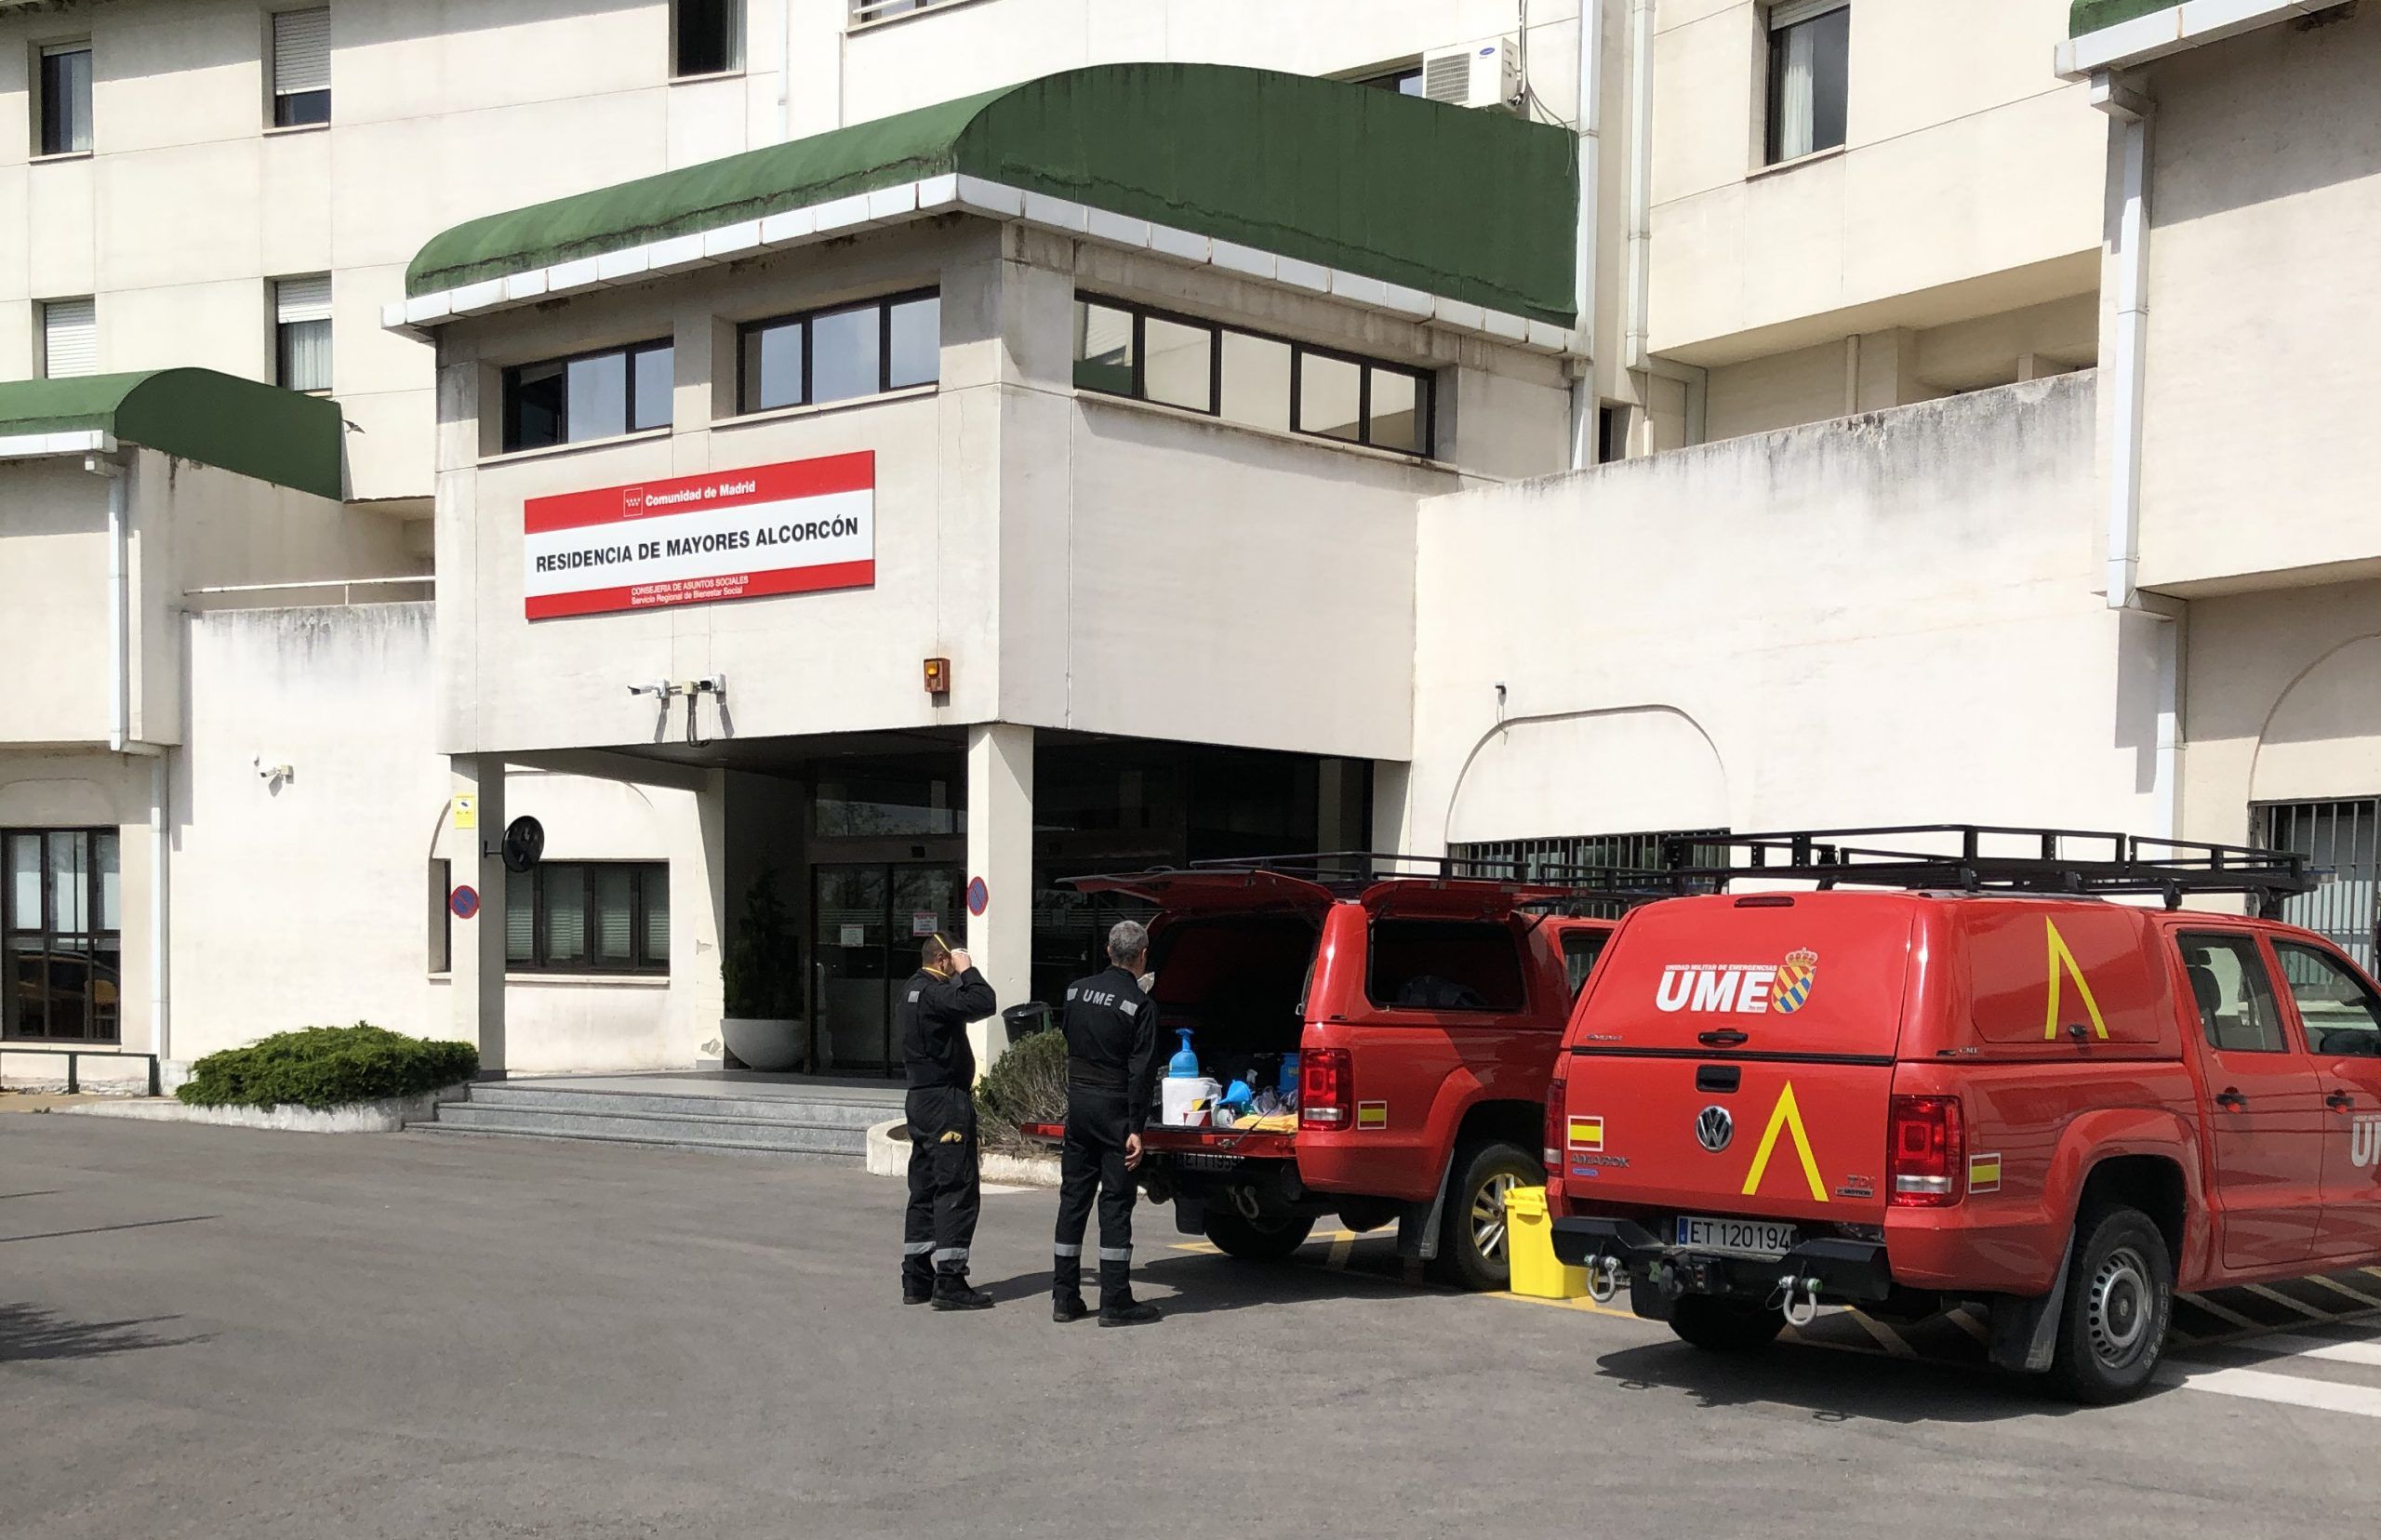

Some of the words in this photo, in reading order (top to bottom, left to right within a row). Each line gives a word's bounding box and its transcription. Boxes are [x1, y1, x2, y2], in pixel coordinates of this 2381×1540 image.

[645, 488, 701, 507] Comunidad
[704, 486, 717, 498] de
[719, 480, 756, 498] Madrid
[536, 545, 632, 573] RESIDENCIA
[638, 541, 661, 561] DE
[667, 530, 751, 558] MAYORES
[755, 513, 858, 547] ALCORCÓN
[672, 582, 682, 591] DE
[683, 578, 714, 591] ASUNTOS
[715, 575, 749, 587] SOCIALES
[631, 595, 656, 605] Servicio
[656, 592, 683, 604] Regional
[684, 591, 692, 600] de
[693, 588, 723, 599] Bienestar
[724, 586, 743, 595] Social
[1728, 963, 1777, 972] EMERGENCIAS
[1083, 989, 1115, 1006] UME
[1656, 971, 1776, 1014] UME
[1690, 1221, 1713, 1244] ET
[1721, 1224, 1790, 1251] 120194
